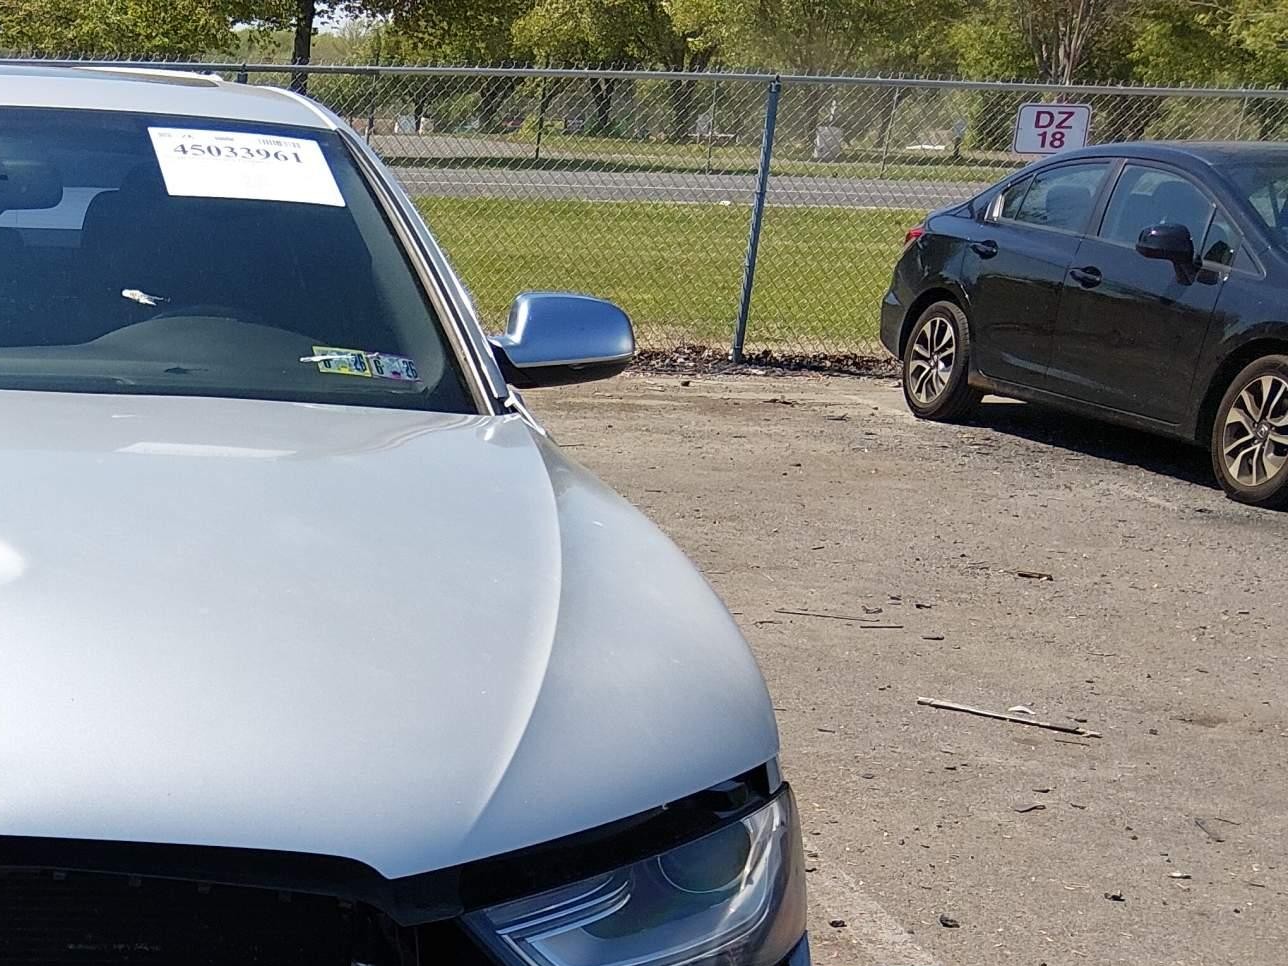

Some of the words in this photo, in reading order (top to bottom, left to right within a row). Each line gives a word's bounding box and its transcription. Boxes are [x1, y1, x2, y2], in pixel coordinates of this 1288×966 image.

[1034, 110, 1075, 130] DZ
[1036, 131, 1066, 149] 18
[173, 143, 304, 164] 45033961
